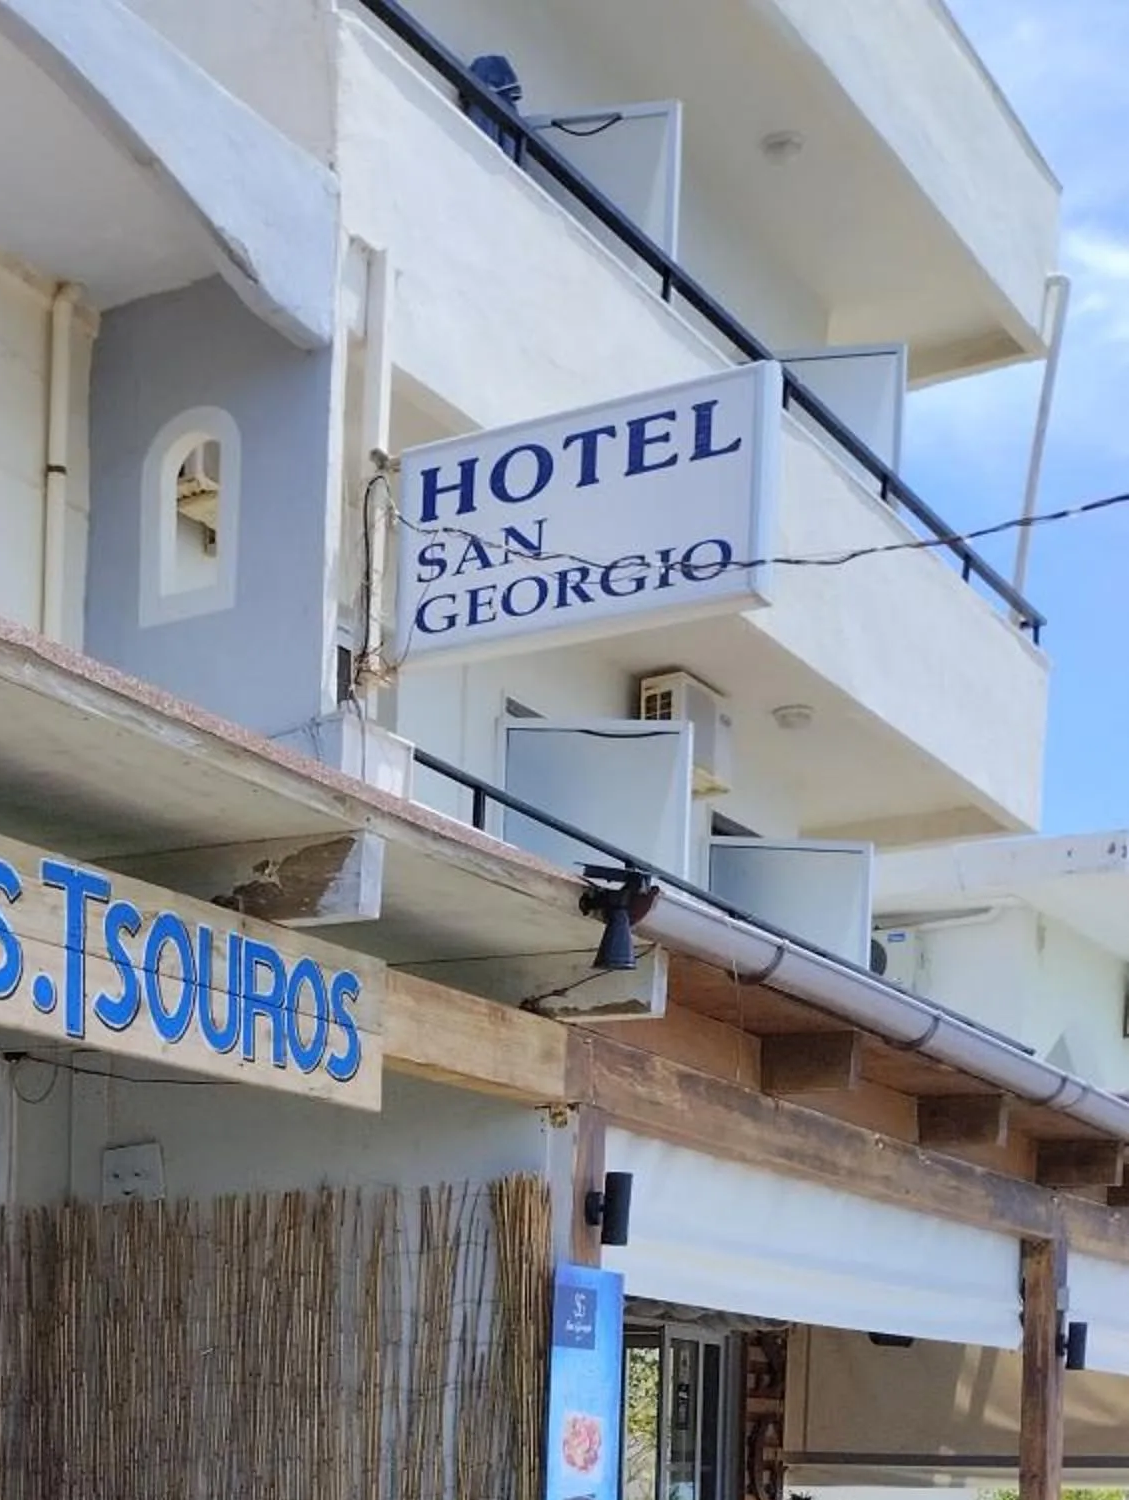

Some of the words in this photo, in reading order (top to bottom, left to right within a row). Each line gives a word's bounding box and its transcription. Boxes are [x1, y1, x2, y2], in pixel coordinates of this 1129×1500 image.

[420, 400, 742, 523] HOTEL
[416, 539, 733, 635] GEORGIO
[417, 518, 548, 583] SAN
